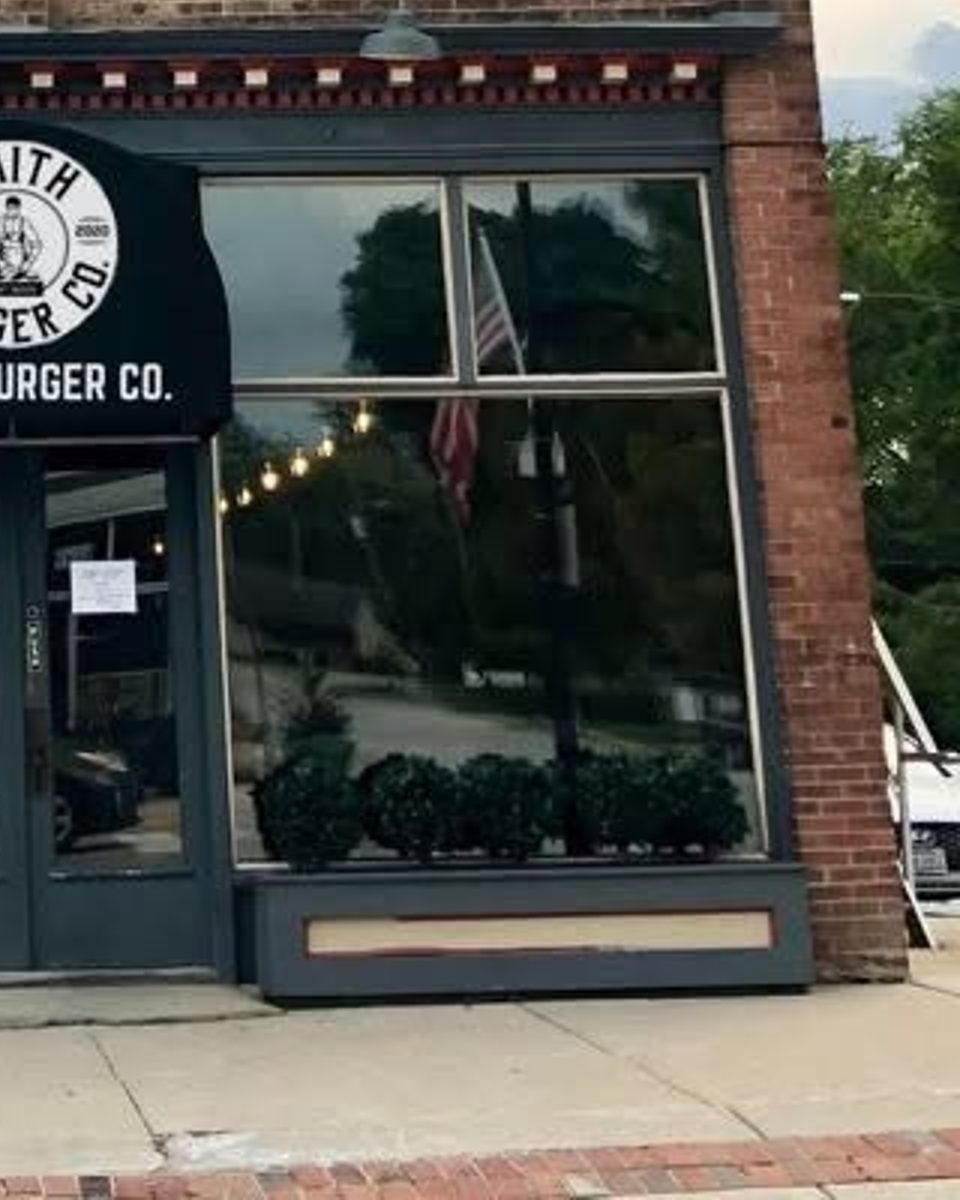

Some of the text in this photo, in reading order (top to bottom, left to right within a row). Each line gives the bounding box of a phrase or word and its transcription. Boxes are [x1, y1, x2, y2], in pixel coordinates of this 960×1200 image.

[74, 224, 110, 237] 2020
[62, 261, 111, 310] CO.
[119, 362, 173, 402] CO.
